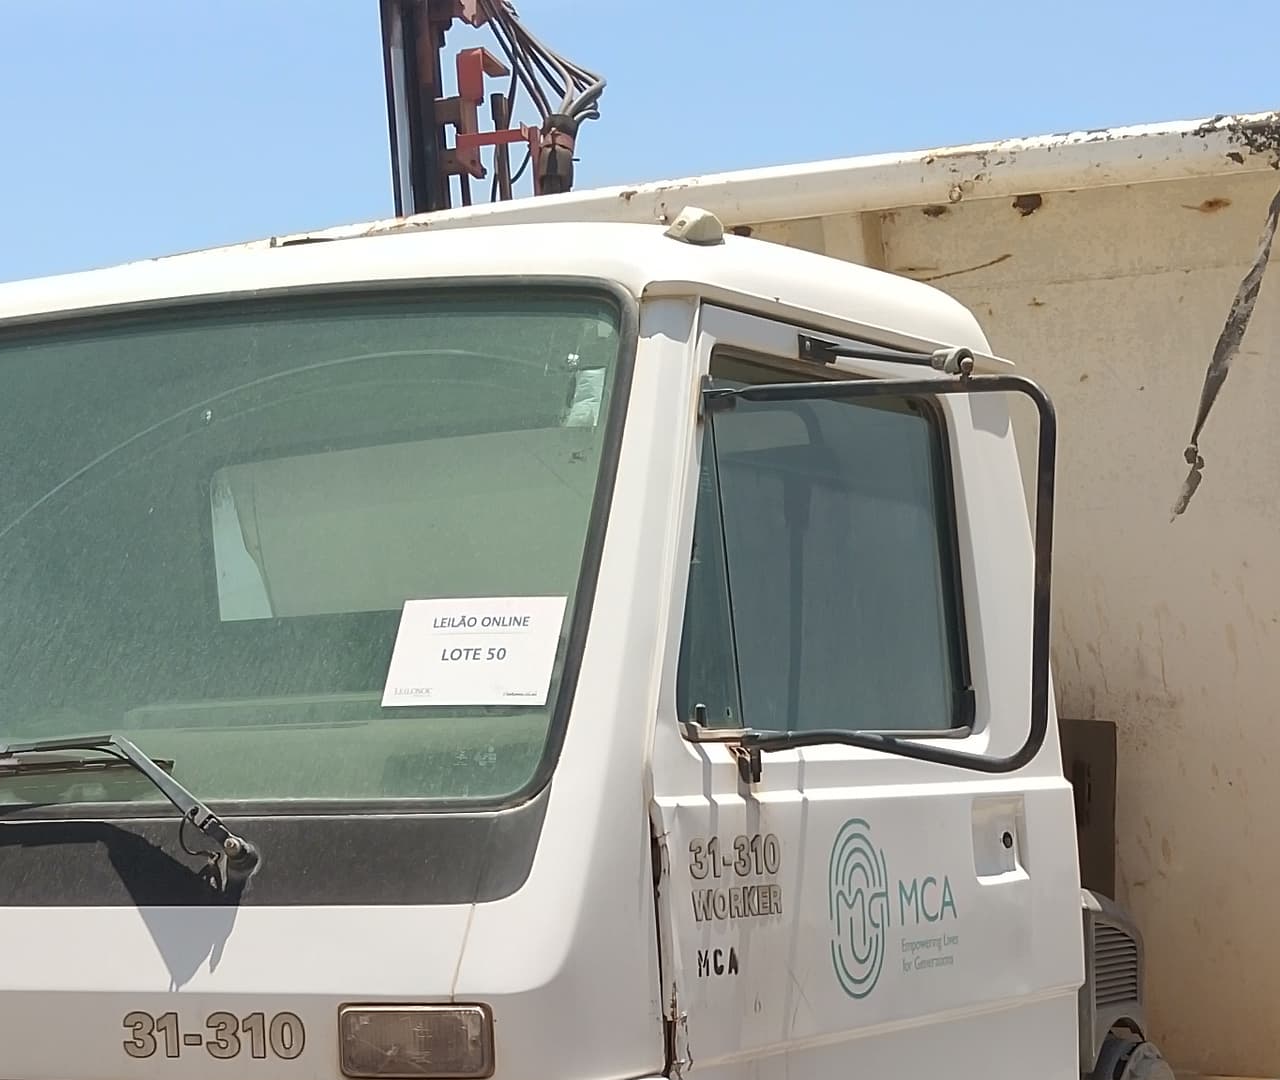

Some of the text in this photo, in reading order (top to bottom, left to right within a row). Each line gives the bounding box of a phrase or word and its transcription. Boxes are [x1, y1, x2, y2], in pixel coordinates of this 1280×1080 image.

[432, 615, 531, 629] LEILÃO ONLINE
[440, 647, 507, 661] LOTE 50
[688, 833, 782, 880] 31-310
[690, 884, 783, 922] WORKER
[898, 874, 958, 927] MCA
[697, 946, 740, 978] MCA
[122, 1011, 306, 1060] 31-310
